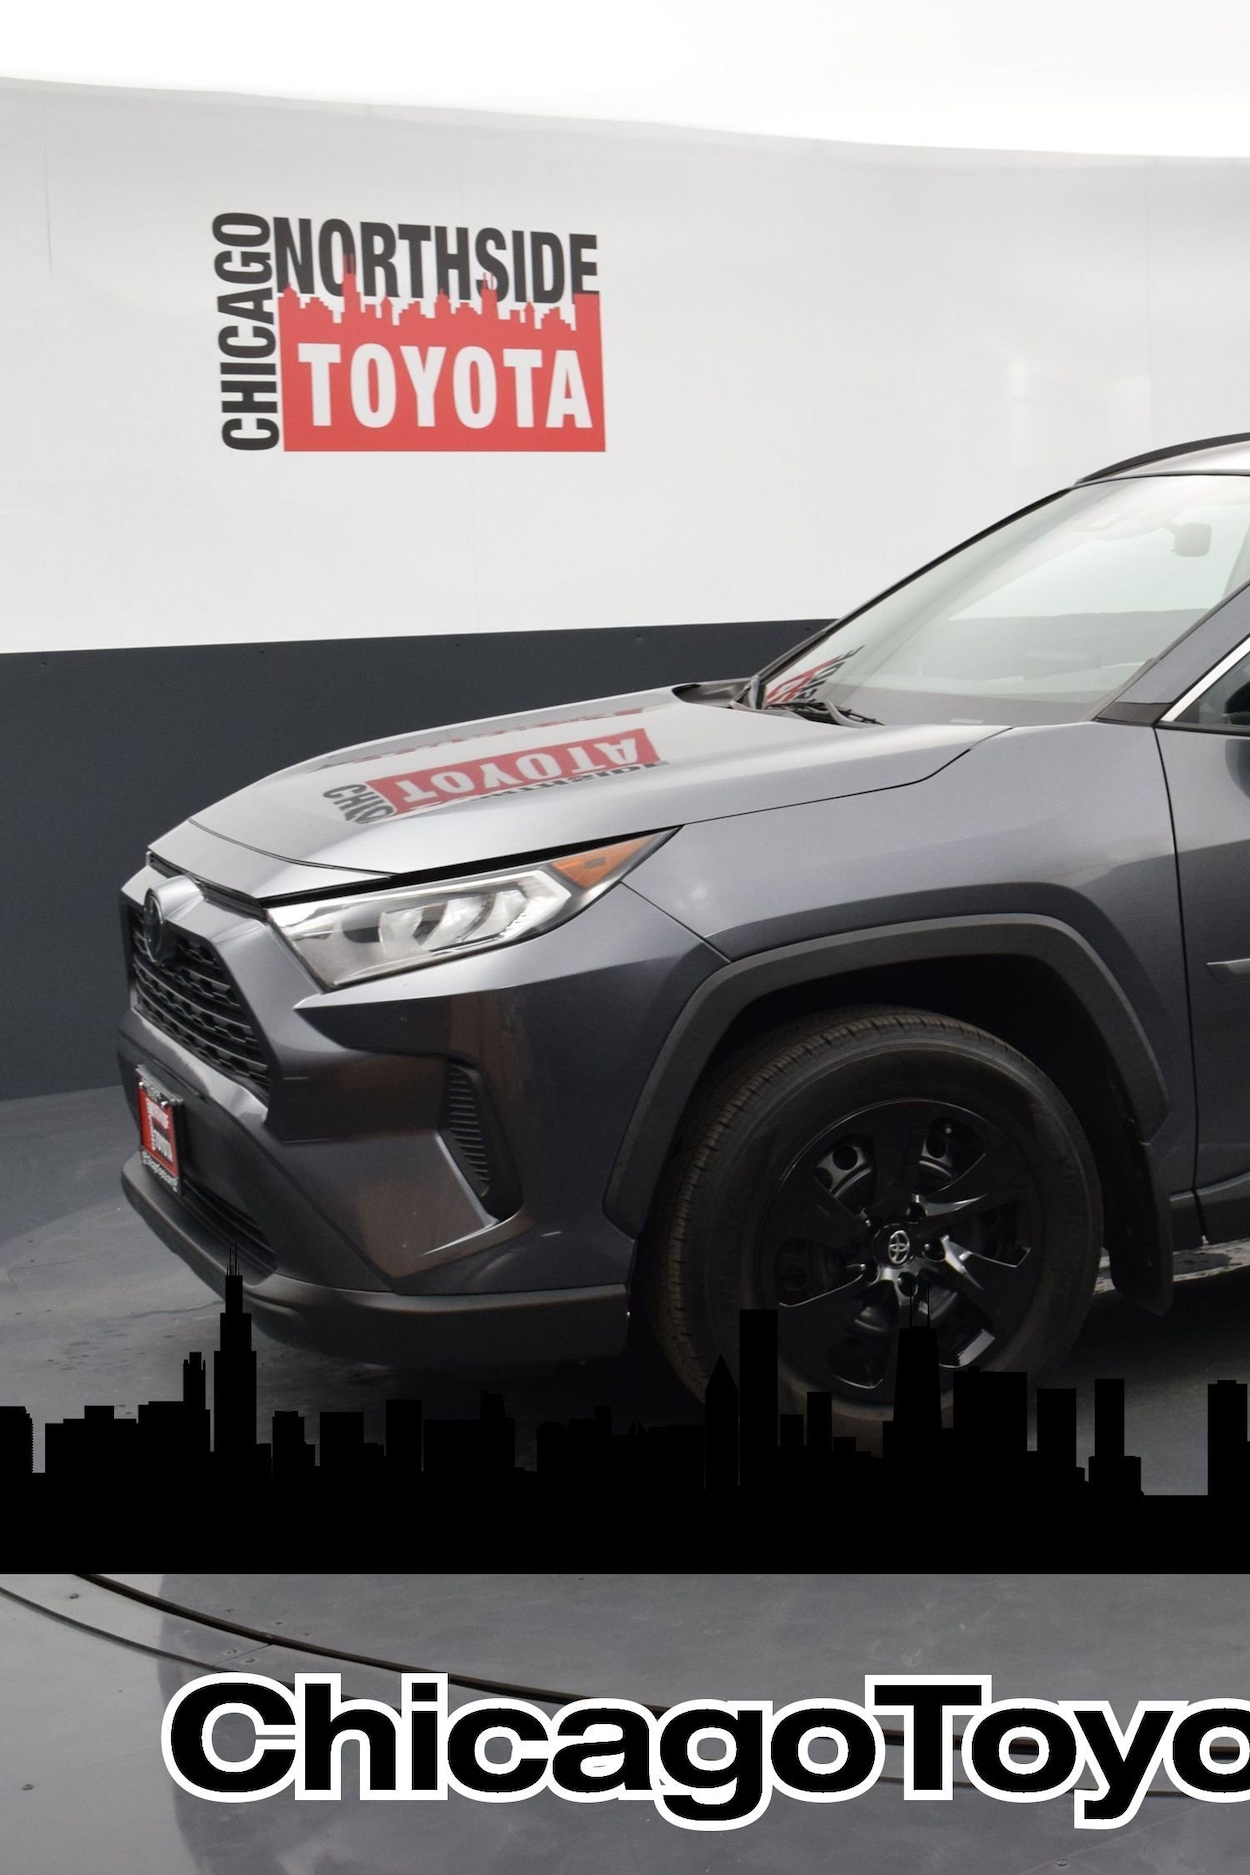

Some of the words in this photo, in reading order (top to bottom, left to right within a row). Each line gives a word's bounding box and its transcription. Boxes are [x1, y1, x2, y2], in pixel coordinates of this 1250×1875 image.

[273, 216, 599, 304] NORTHSIDE
[212, 212, 280, 451] CHICAGO
[298, 343, 593, 429] TOYOTA
